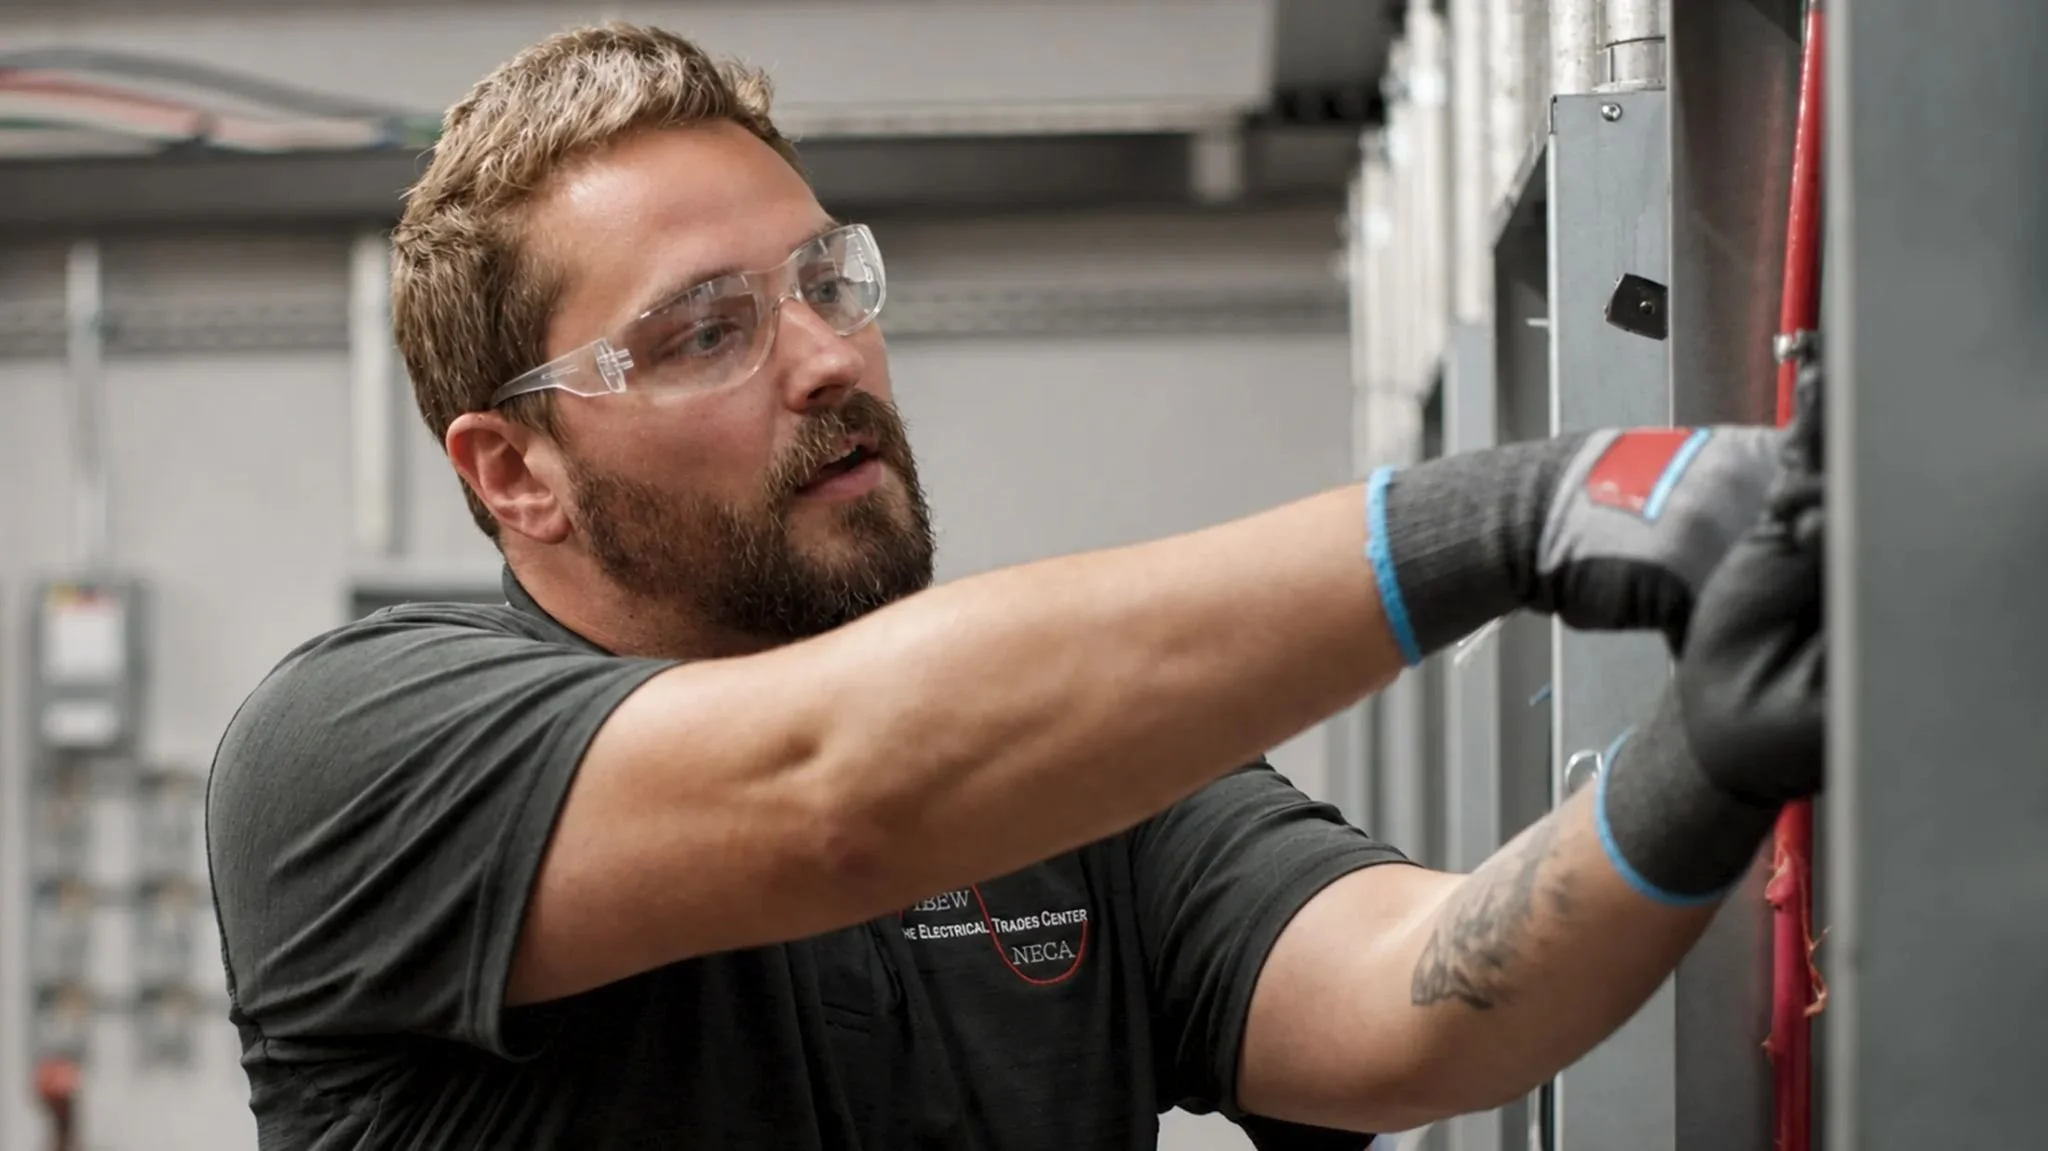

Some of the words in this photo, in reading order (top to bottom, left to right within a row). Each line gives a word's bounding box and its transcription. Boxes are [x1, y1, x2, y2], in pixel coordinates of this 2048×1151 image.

[902, 927, 917, 940] HE
[918, 921, 990, 939] ELECTRICAL
[991, 915, 1040, 934] TRADES
[1041, 909, 1088, 927] CENTER
[1011, 940, 1076, 965] NECA
